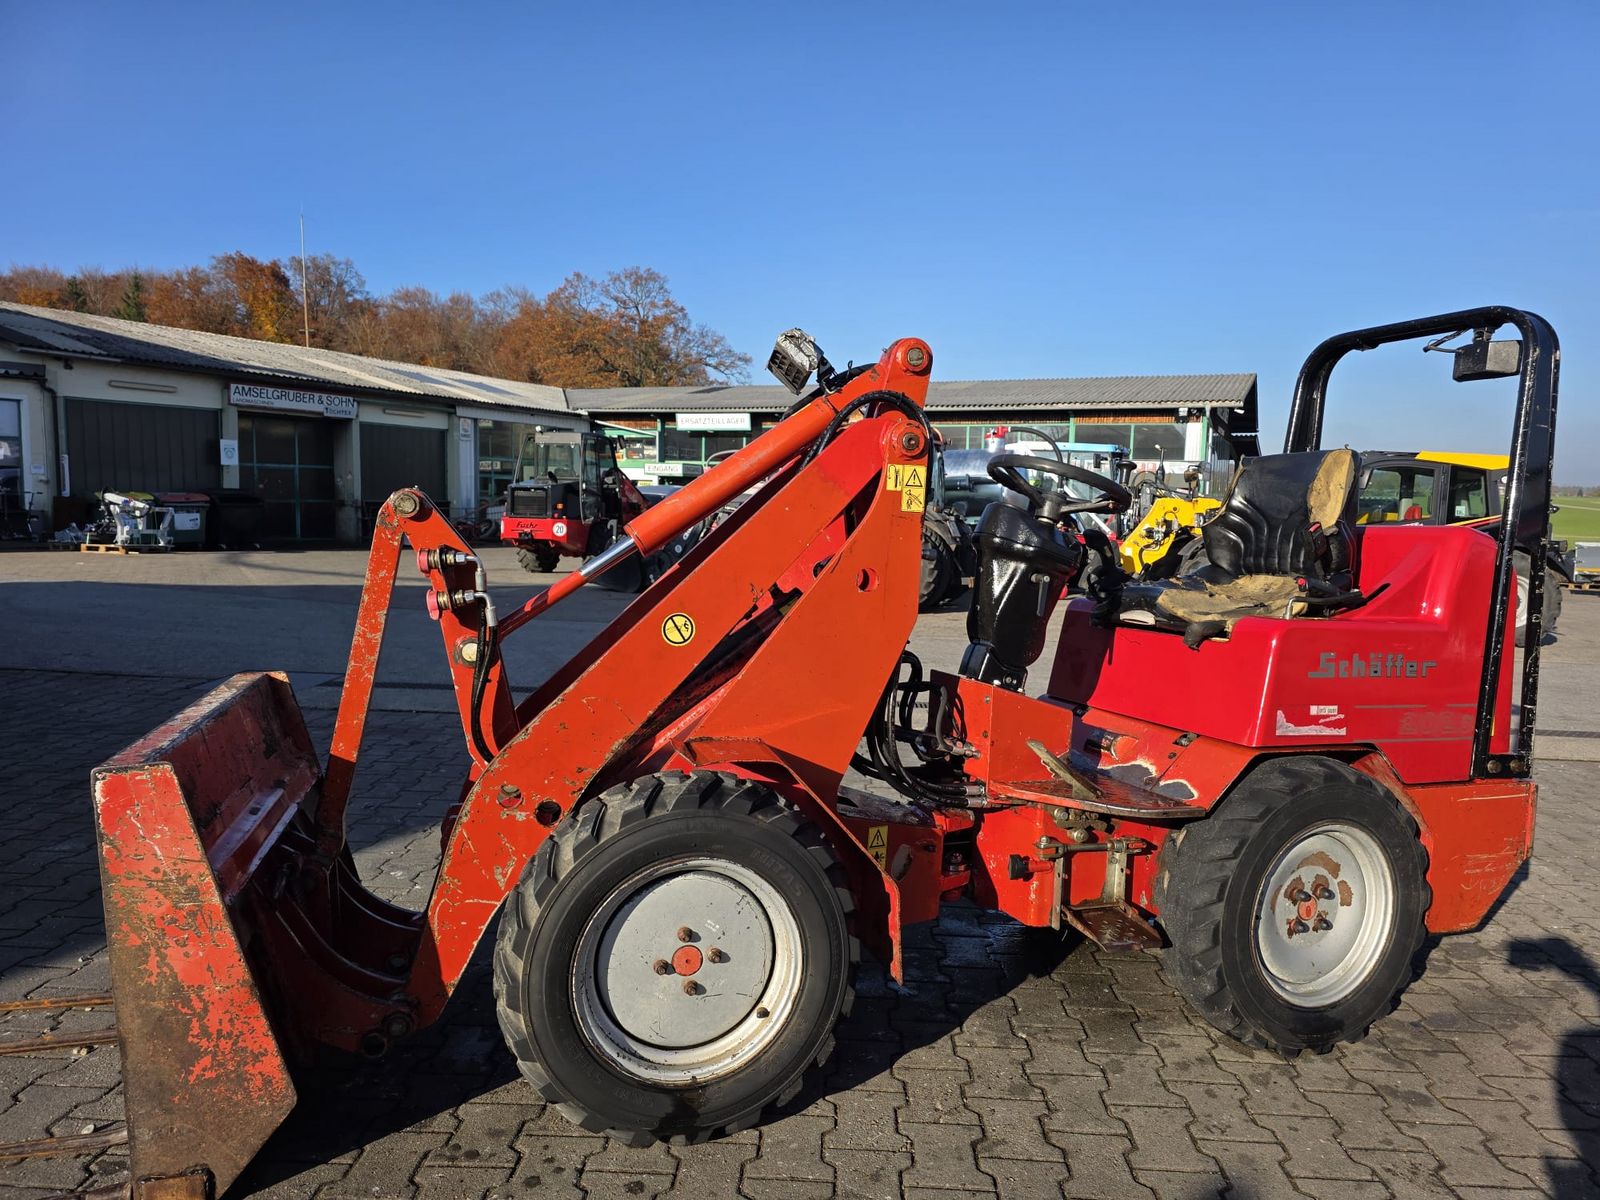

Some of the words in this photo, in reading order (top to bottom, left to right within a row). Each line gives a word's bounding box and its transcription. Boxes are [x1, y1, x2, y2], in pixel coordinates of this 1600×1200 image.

[232, 386, 316, 405] AMSELGRUBER
[317, 395, 324, 405] &
[326, 396, 355, 408] SOHN
[681, 417, 745, 425] ERSATZTEILLAGER
[647, 465, 679, 473] EINGANG
[555, 525, 564, 534] 20
[1308, 652, 1437, 678] Schäffer
